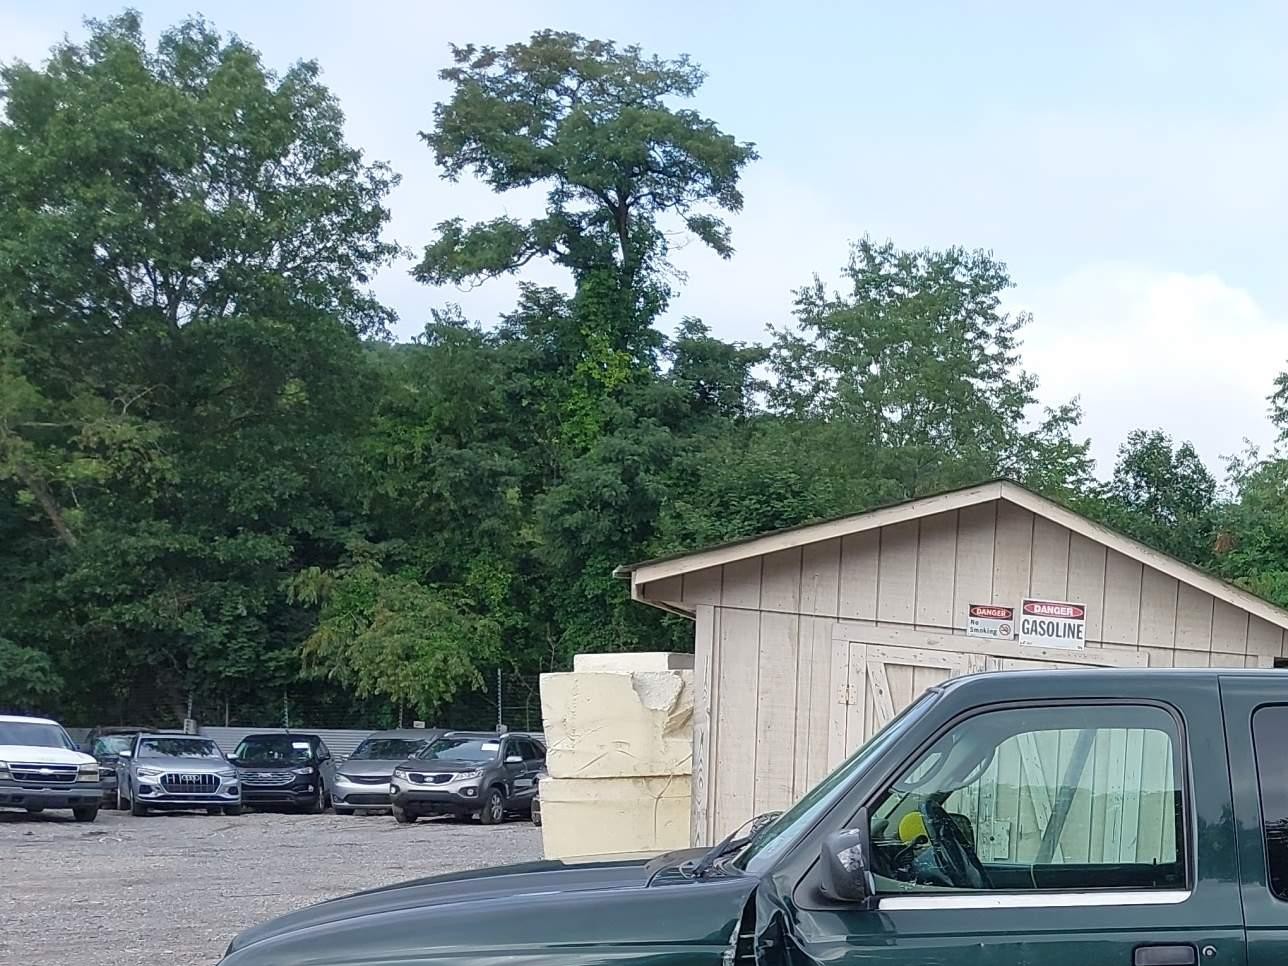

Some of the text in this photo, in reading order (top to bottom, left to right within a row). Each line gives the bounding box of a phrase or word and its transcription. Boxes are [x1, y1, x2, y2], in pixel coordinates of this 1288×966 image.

[976, 608, 1006, 617] DANGER
[1033, 604, 1073, 616] DANGER
[969, 626, 997, 636] Smoking
[1022, 618, 1084, 640] GASOLINE
